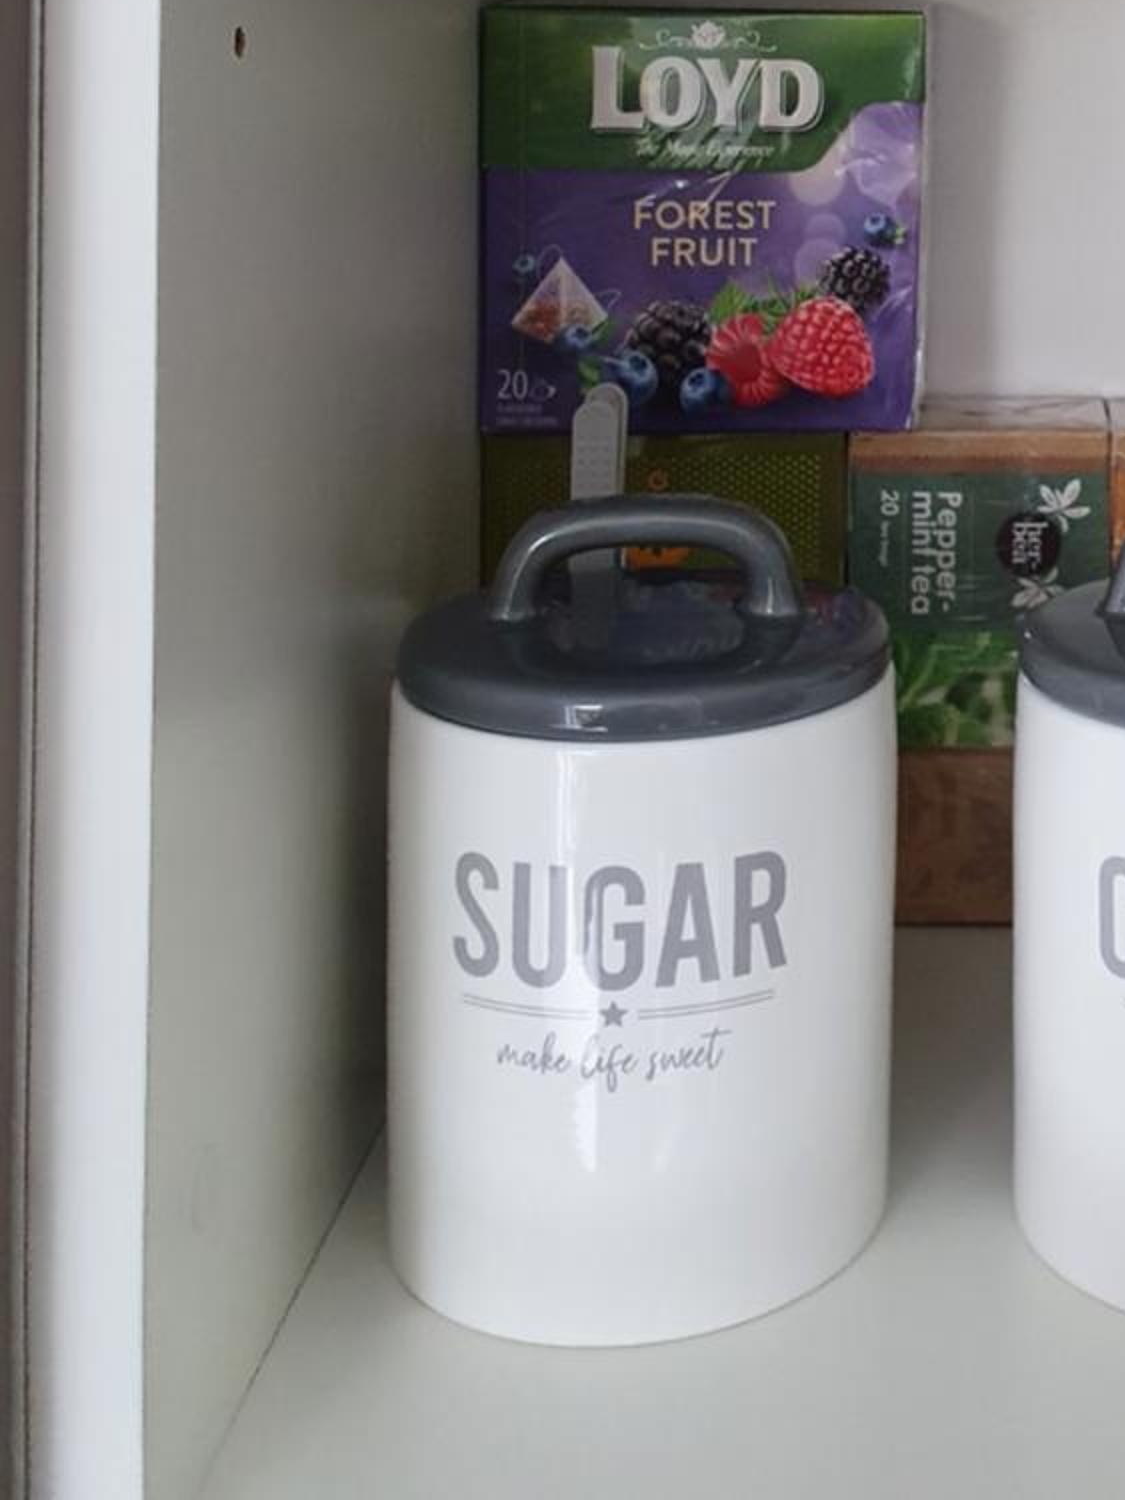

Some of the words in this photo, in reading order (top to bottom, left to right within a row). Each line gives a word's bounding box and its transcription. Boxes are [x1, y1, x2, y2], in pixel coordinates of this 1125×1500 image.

[590, 45, 824, 133] LOYD
[634, 200, 776, 230] FOREST
[651, 238, 758, 267] FRUIT
[497, 369, 528, 400] 20
[881, 490, 899, 516] 20
[911, 491, 936, 557] mint
[933, 491, 962, 612] Pepper-
[911, 565, 936, 615] tea
[453, 851, 787, 991] SUGAR
[496, 1032, 571, 1075] make
[579, 1033, 638, 1092] life
[647, 1026, 732, 1081] sweet
